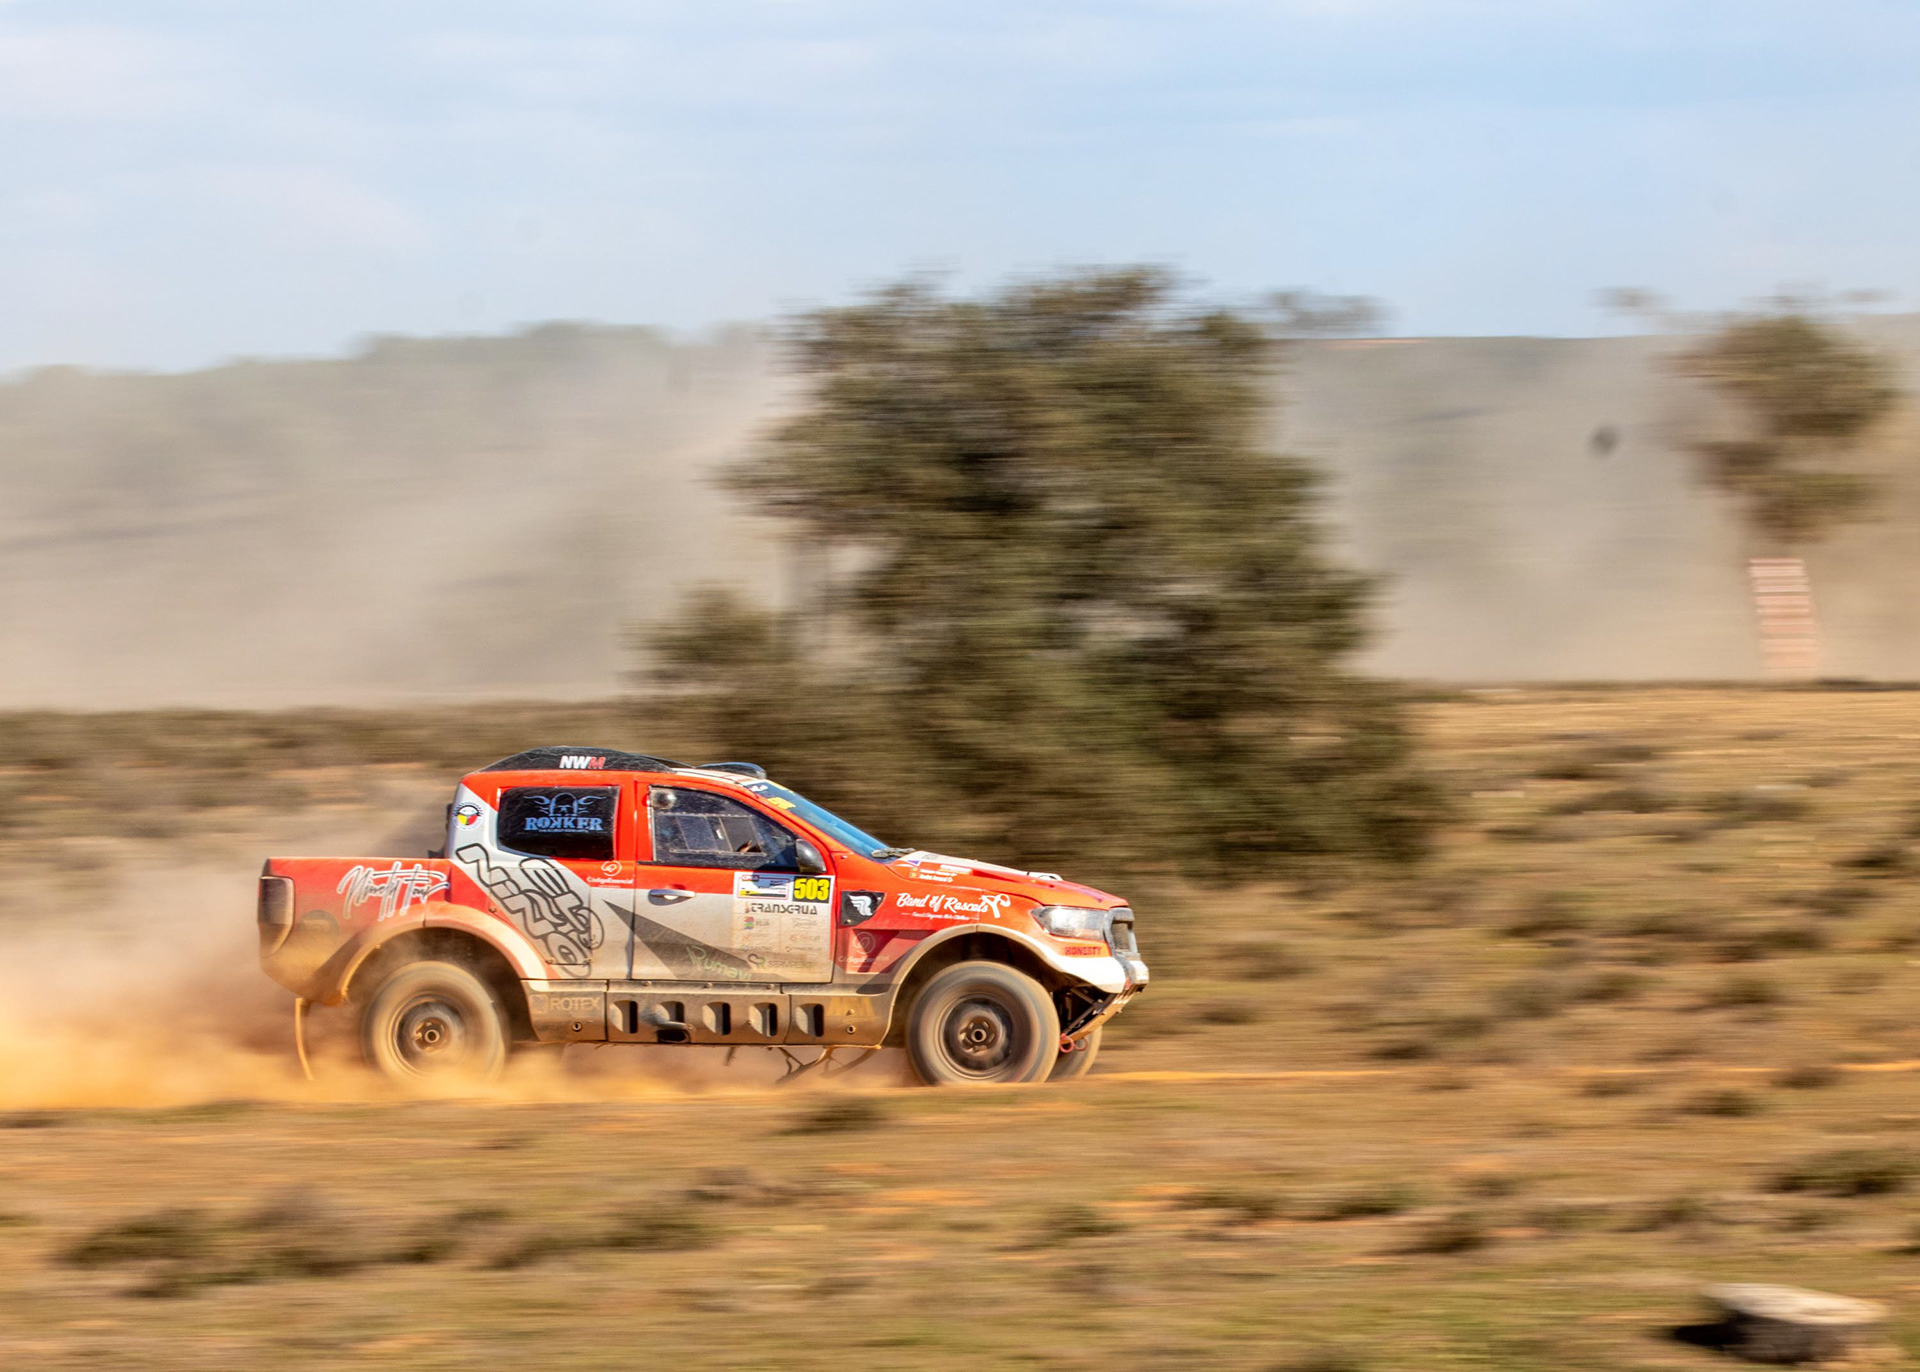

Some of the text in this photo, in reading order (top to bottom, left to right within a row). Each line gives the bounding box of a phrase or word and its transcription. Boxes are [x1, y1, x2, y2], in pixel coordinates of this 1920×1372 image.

[559, 755, 606, 769] NWM
[524, 816, 603, 831] ROKKER
[794, 878, 830, 901] 503
[751, 903, 818, 915] TRANSGRUA
[896, 892, 989, 914] Band of Rascals
[1064, 946, 1102, 956] HONESTY
[550, 997, 601, 1011] ROTEX
